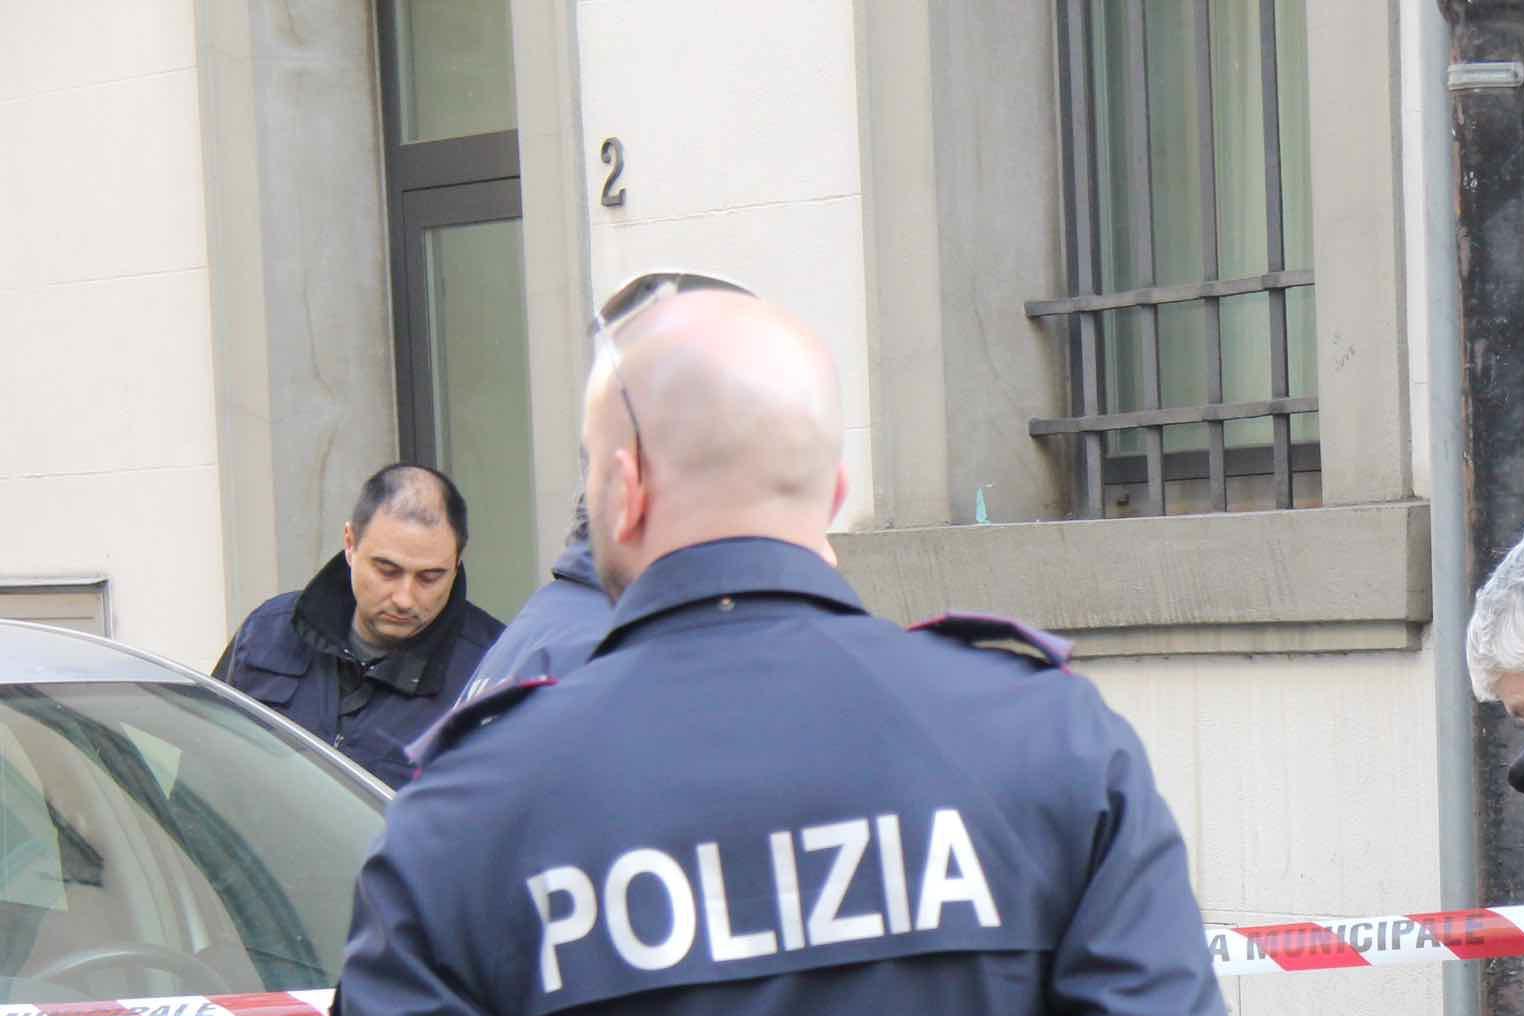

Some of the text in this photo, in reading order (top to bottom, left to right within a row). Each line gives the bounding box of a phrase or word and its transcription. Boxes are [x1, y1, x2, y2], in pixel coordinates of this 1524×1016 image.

[600, 136, 626, 207] 2
[526, 808, 1001, 993] POLIZIA
[1246, 914, 1486, 961] MUNICIPALE
